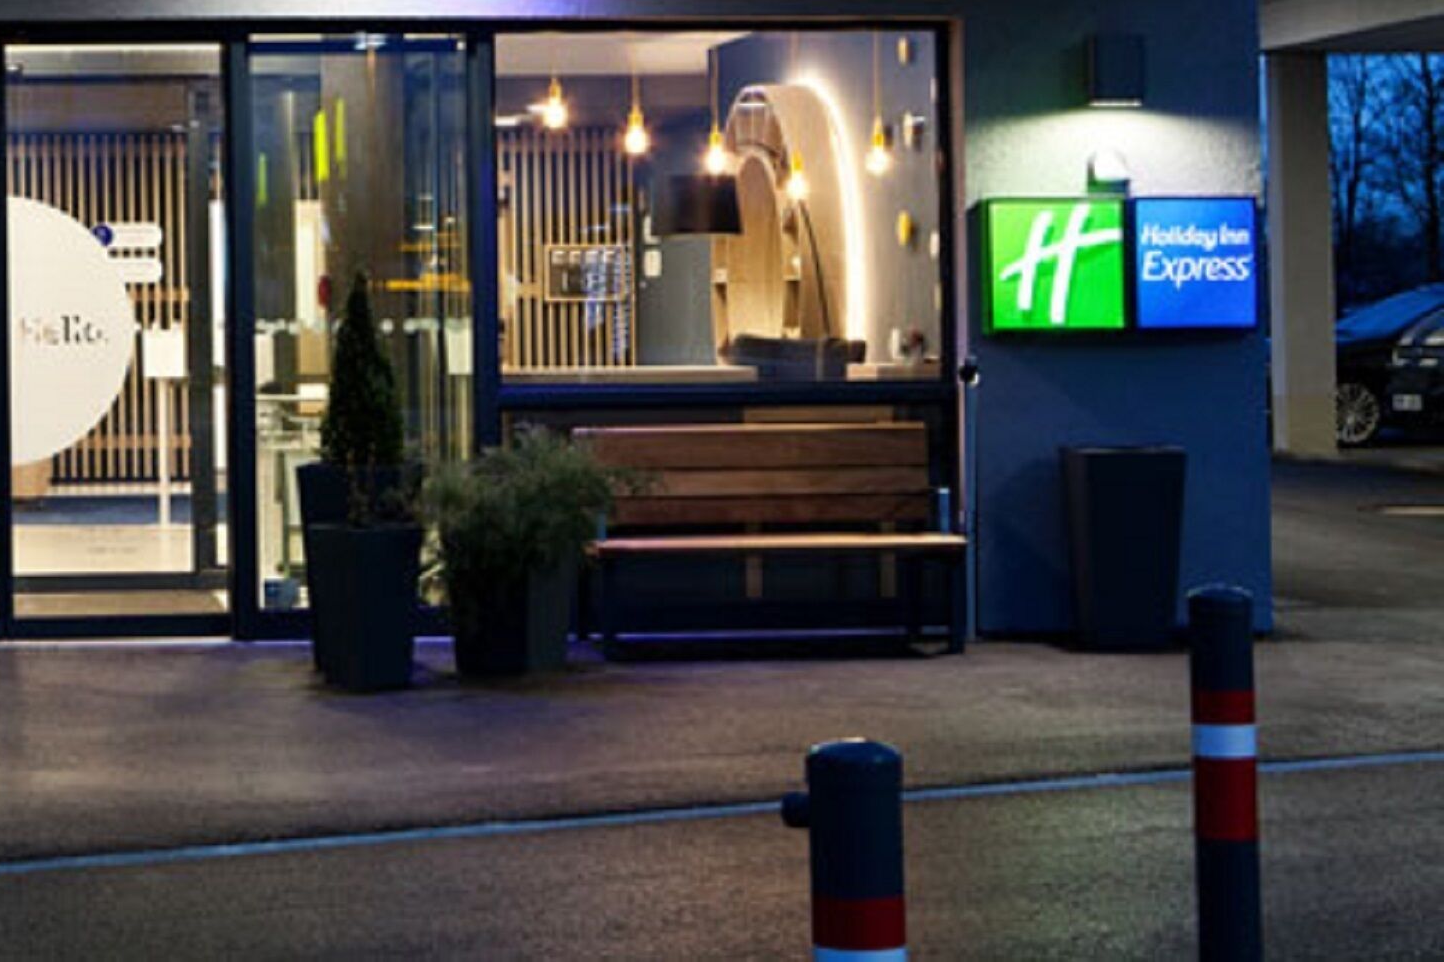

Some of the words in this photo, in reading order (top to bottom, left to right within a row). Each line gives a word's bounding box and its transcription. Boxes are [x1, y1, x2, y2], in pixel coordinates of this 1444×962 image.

[1140, 224, 1218, 251] Holiday
[1218, 224, 1249, 245] Inn
[1141, 250, 1252, 291] Express
